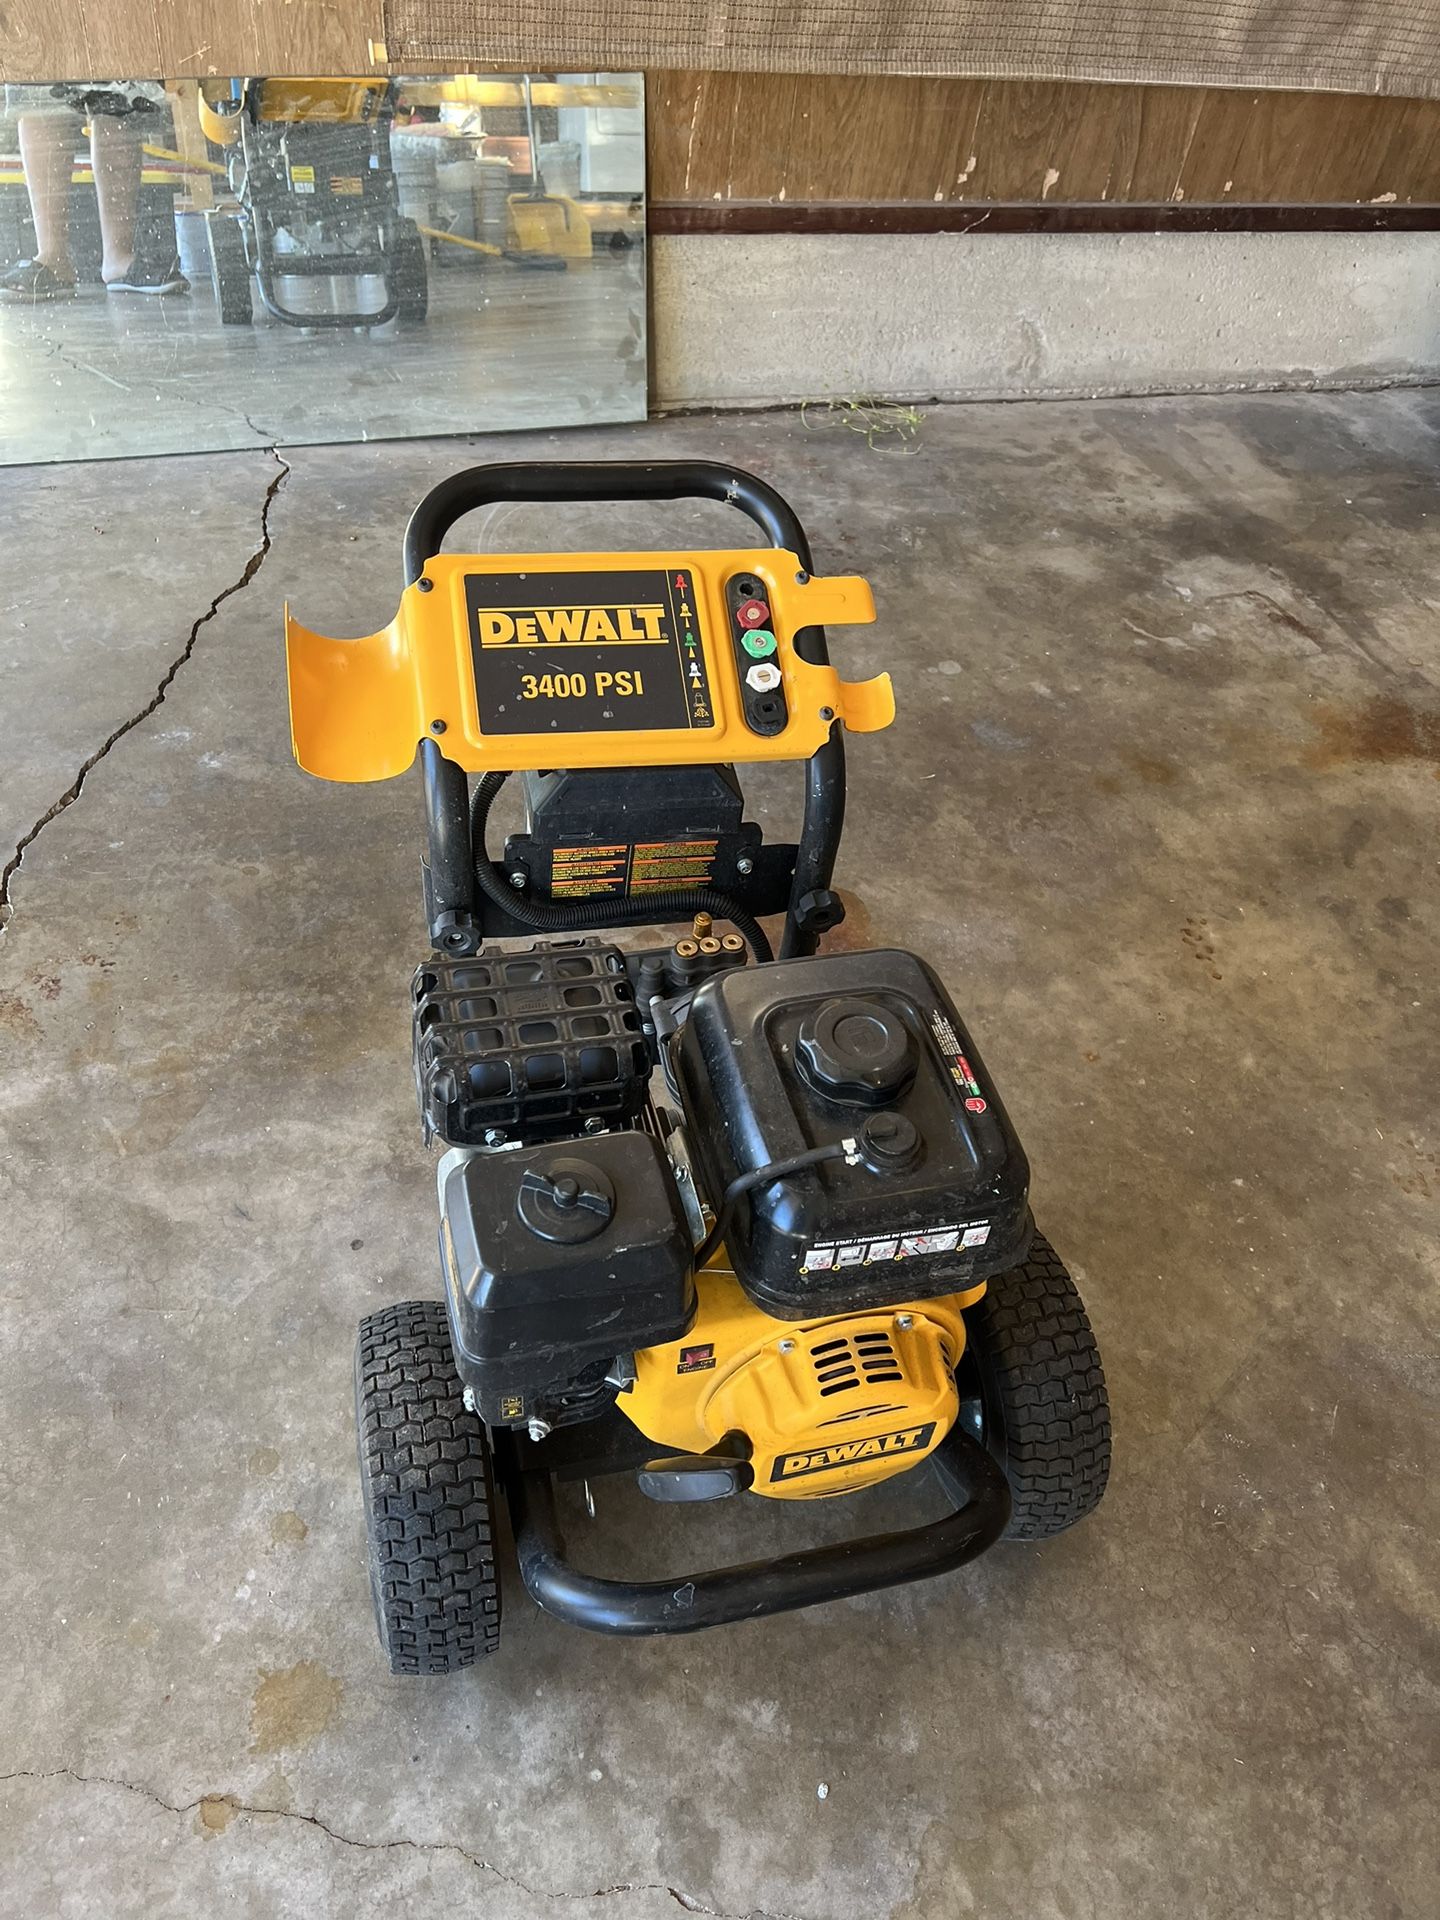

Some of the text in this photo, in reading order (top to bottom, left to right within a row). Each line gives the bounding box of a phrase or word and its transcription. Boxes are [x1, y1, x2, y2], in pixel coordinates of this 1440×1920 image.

[521, 671, 644, 699] 3400 PSI
[813, 1241, 835, 1249] ENGINE
[782, 1427, 924, 1476] DEWALT
